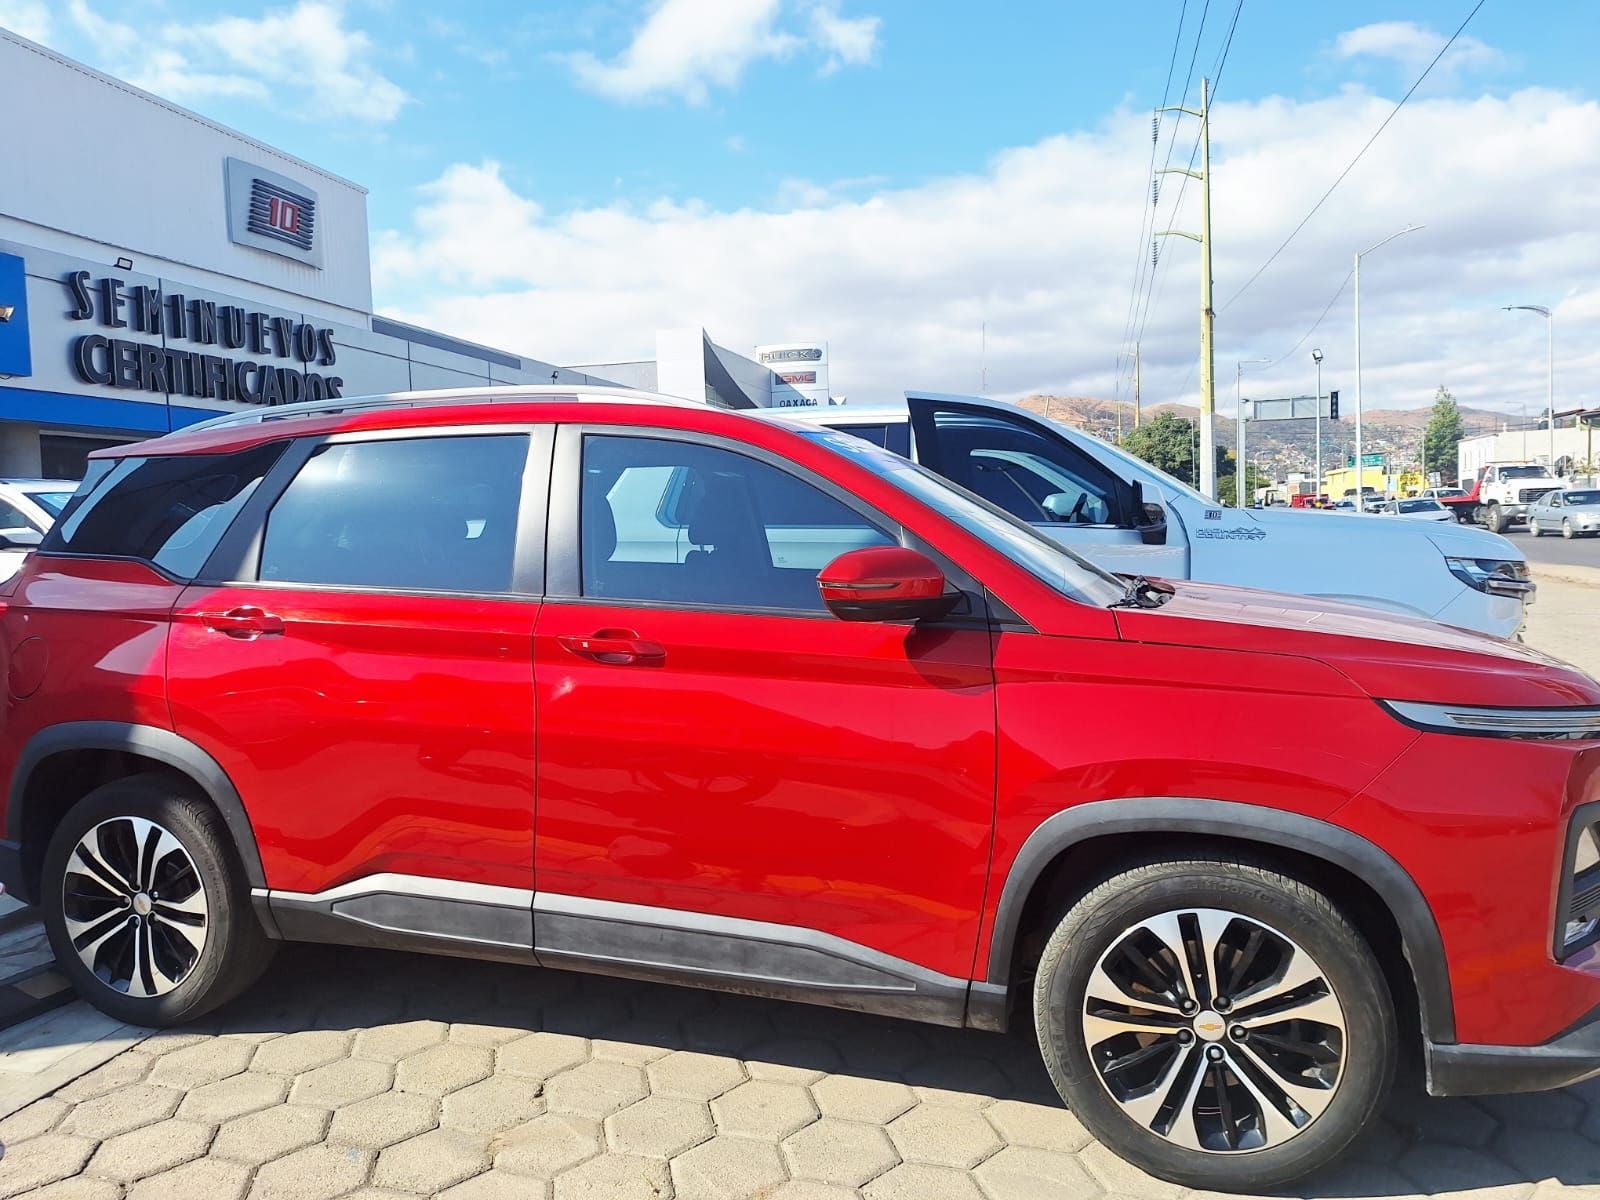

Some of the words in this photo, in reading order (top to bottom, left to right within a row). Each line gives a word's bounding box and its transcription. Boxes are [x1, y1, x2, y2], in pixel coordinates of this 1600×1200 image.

[268, 197, 299, 233] 10
[70, 270, 336, 366] SEMINUEVOS
[76, 334, 344, 406] CERTIFICADOS
[779, 398, 818, 408] OAXACA
